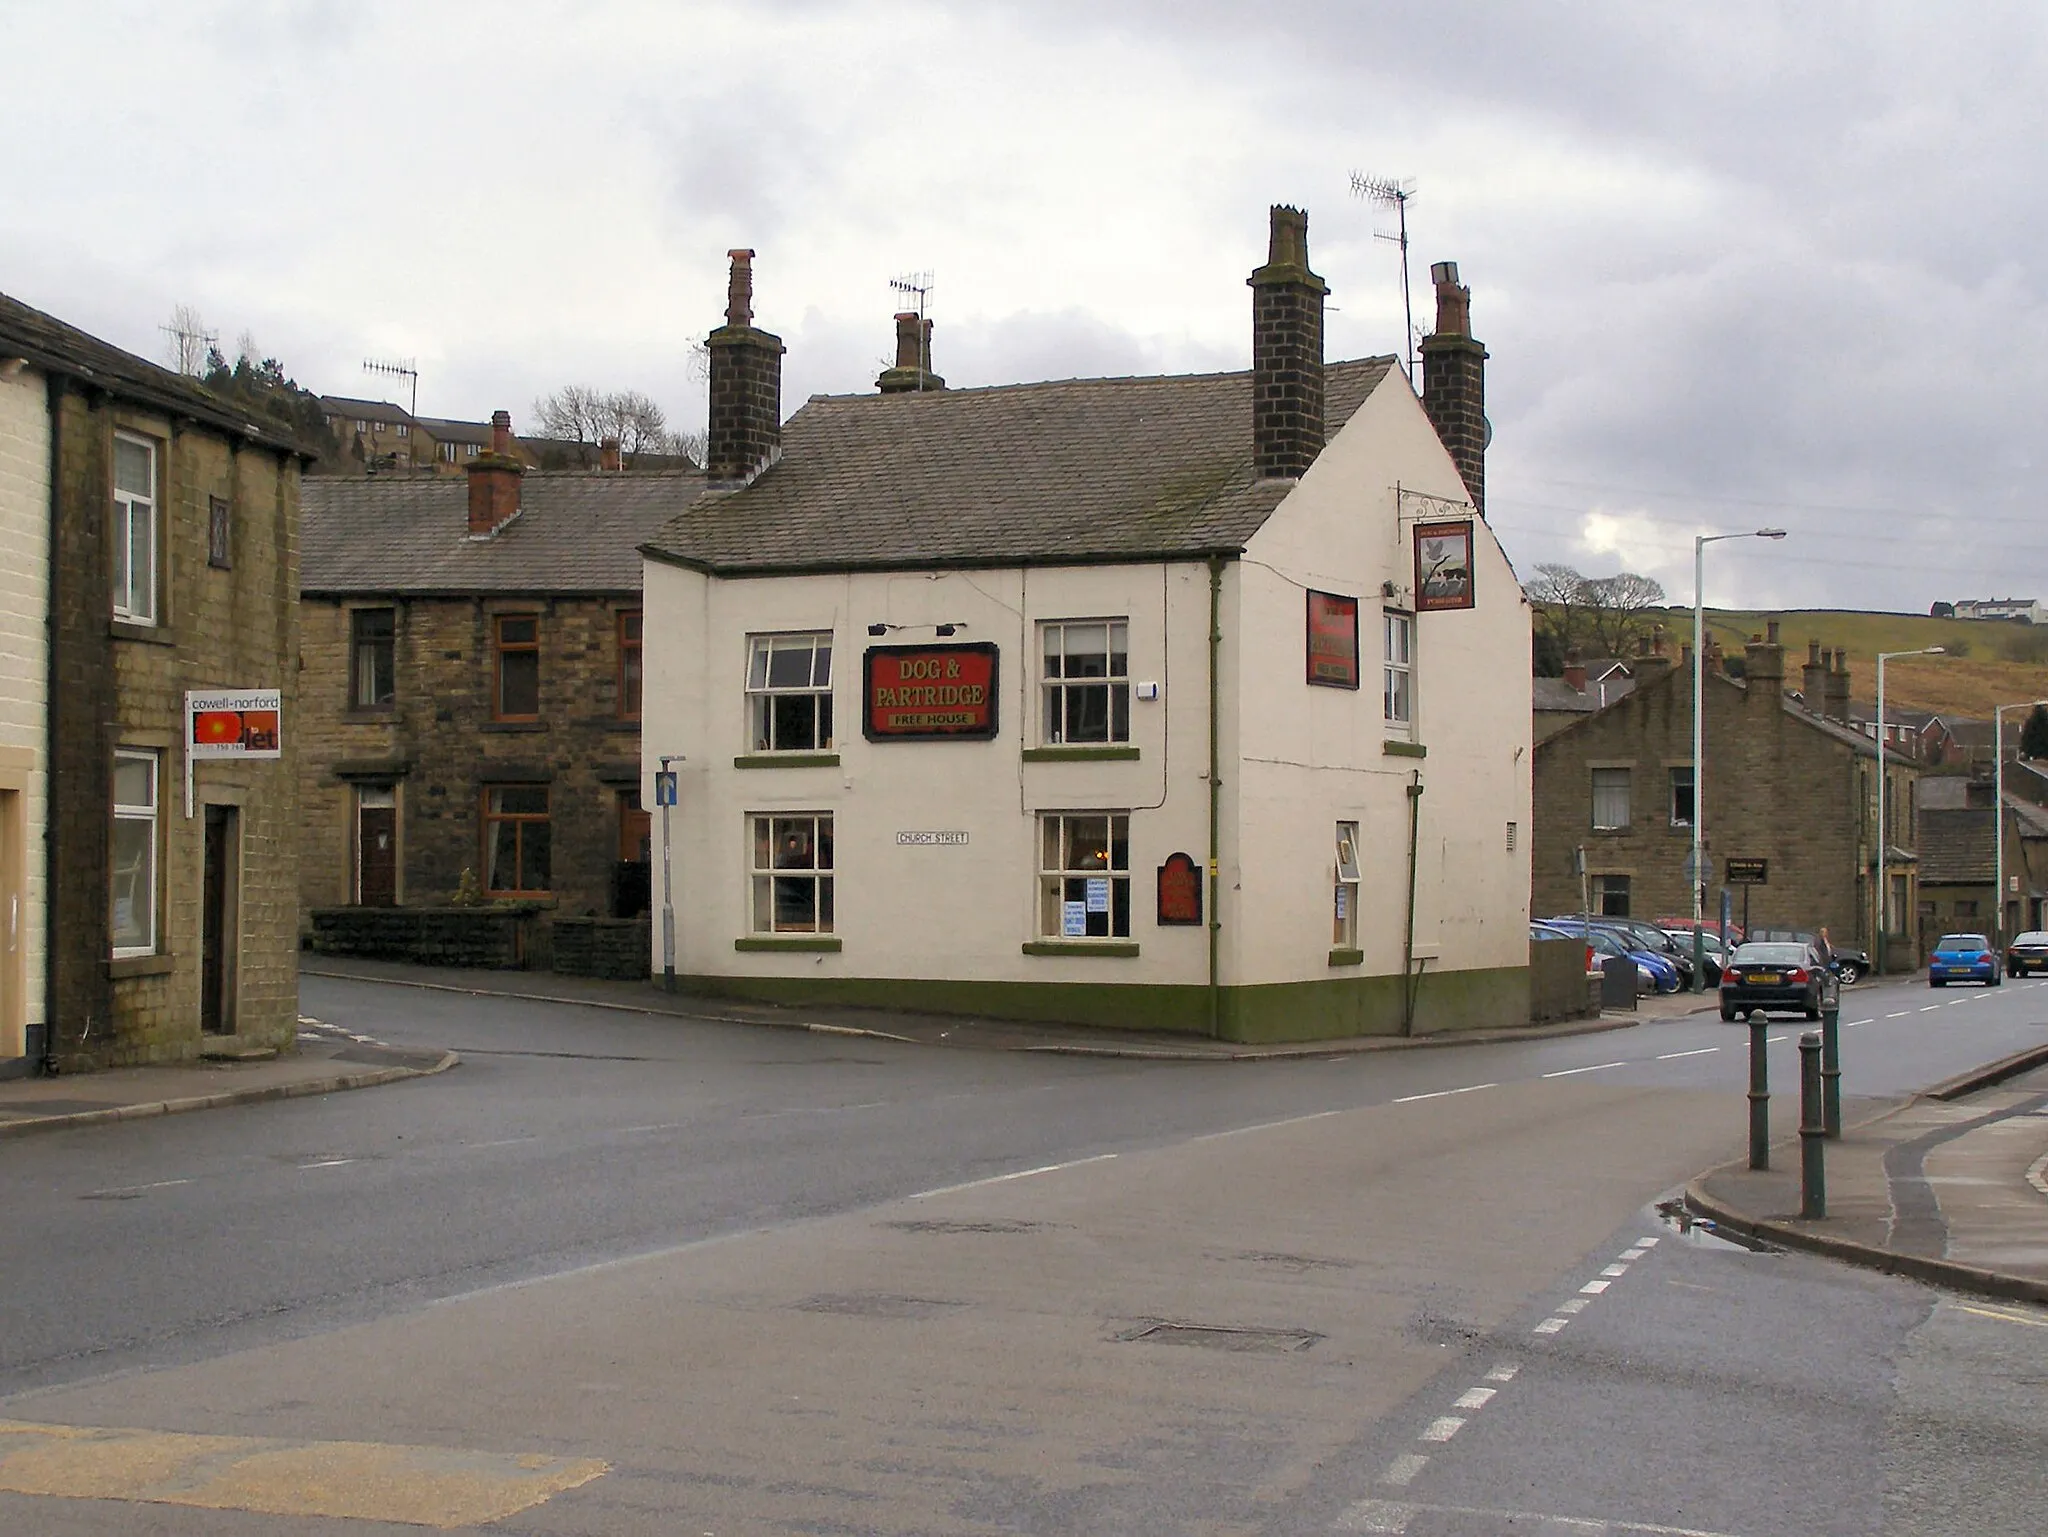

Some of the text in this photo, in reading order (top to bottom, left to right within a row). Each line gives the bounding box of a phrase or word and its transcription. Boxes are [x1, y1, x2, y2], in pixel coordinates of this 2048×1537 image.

[900, 658, 961, 680] DOG &
[192, 696, 278, 709] cowell-norford
[876, 684, 984, 707] PARTRIDGE
[895, 713, 968, 725] FREE HOUSE
[246, 727, 273, 748] let
[900, 833, 964, 843] CHURCH STREET
